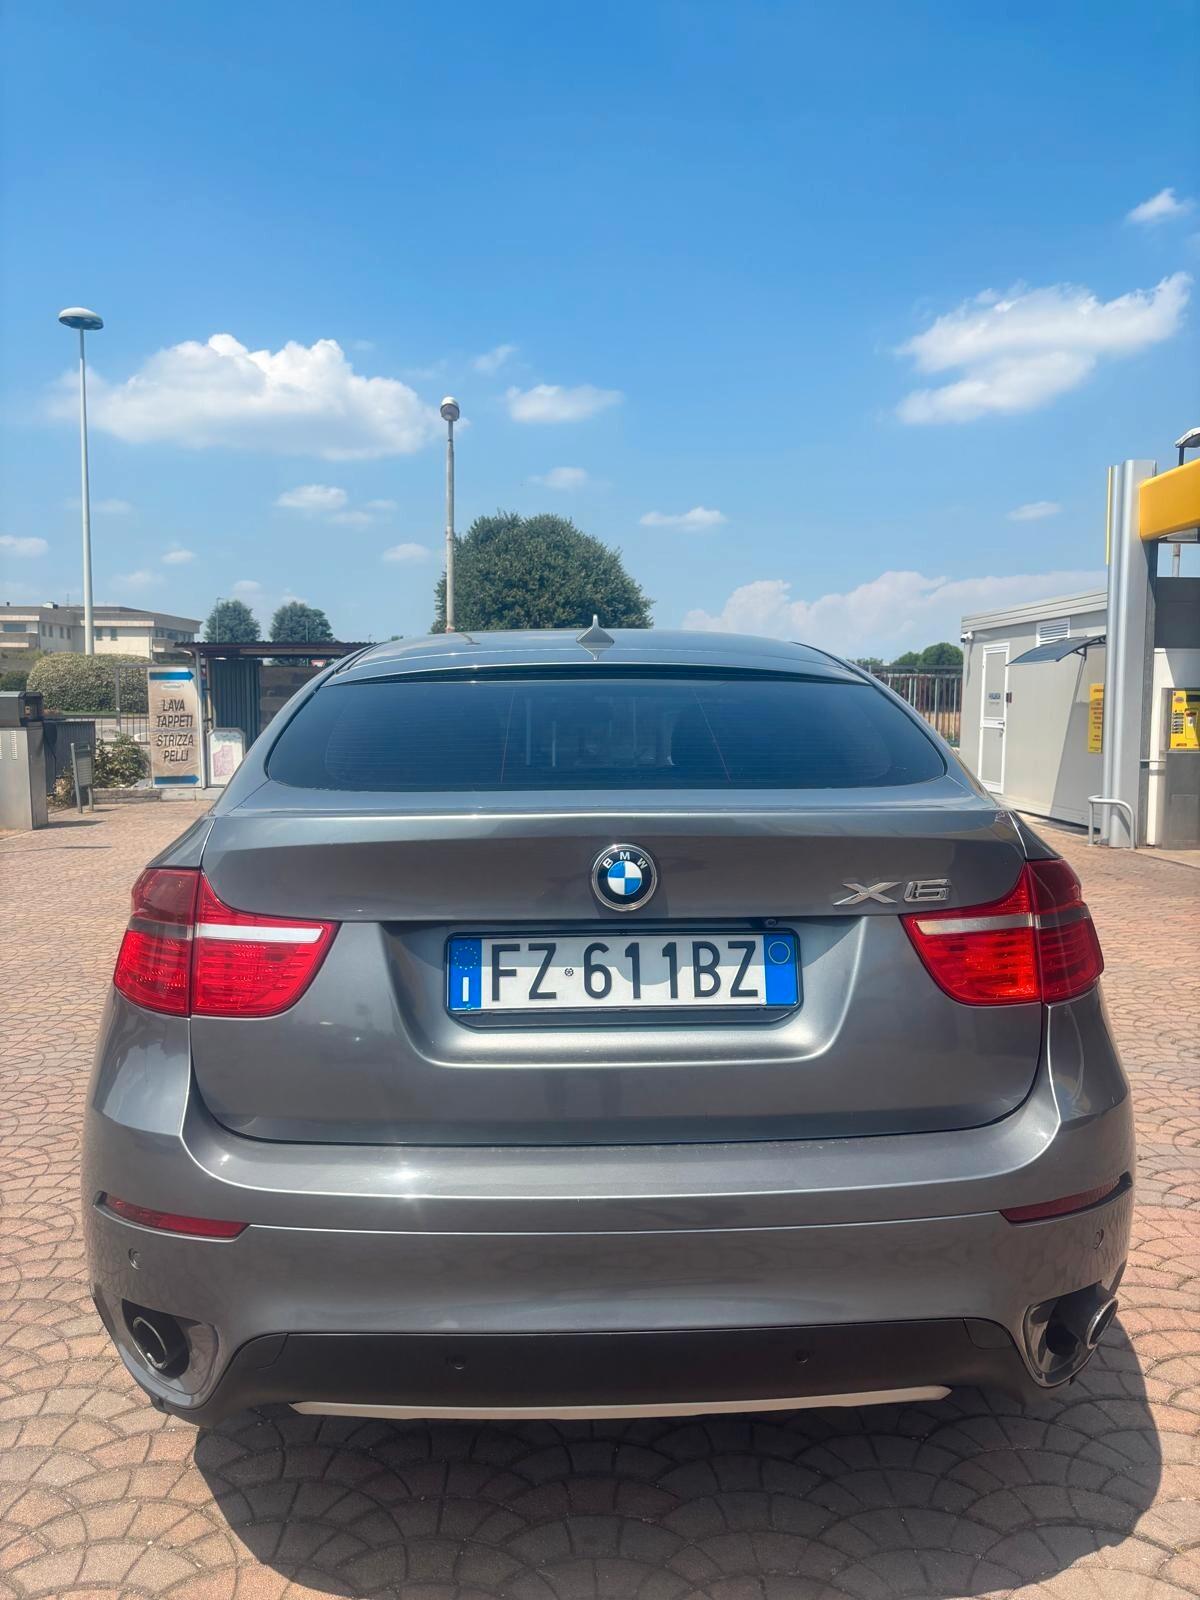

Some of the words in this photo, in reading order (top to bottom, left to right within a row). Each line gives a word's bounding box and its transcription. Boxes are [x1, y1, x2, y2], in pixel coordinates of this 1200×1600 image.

[162, 699, 185, 712] LAVA
[157, 714, 193, 728] TAPPETI
[156, 734, 194, 747] STRIZZA
[163, 750, 189, 762] PELLI
[602, 851, 648, 870] BMW
[832, 879, 951, 905] X6
[491, 942, 557, 1001] FZ
[583, 940, 759, 1000] 611BZ
